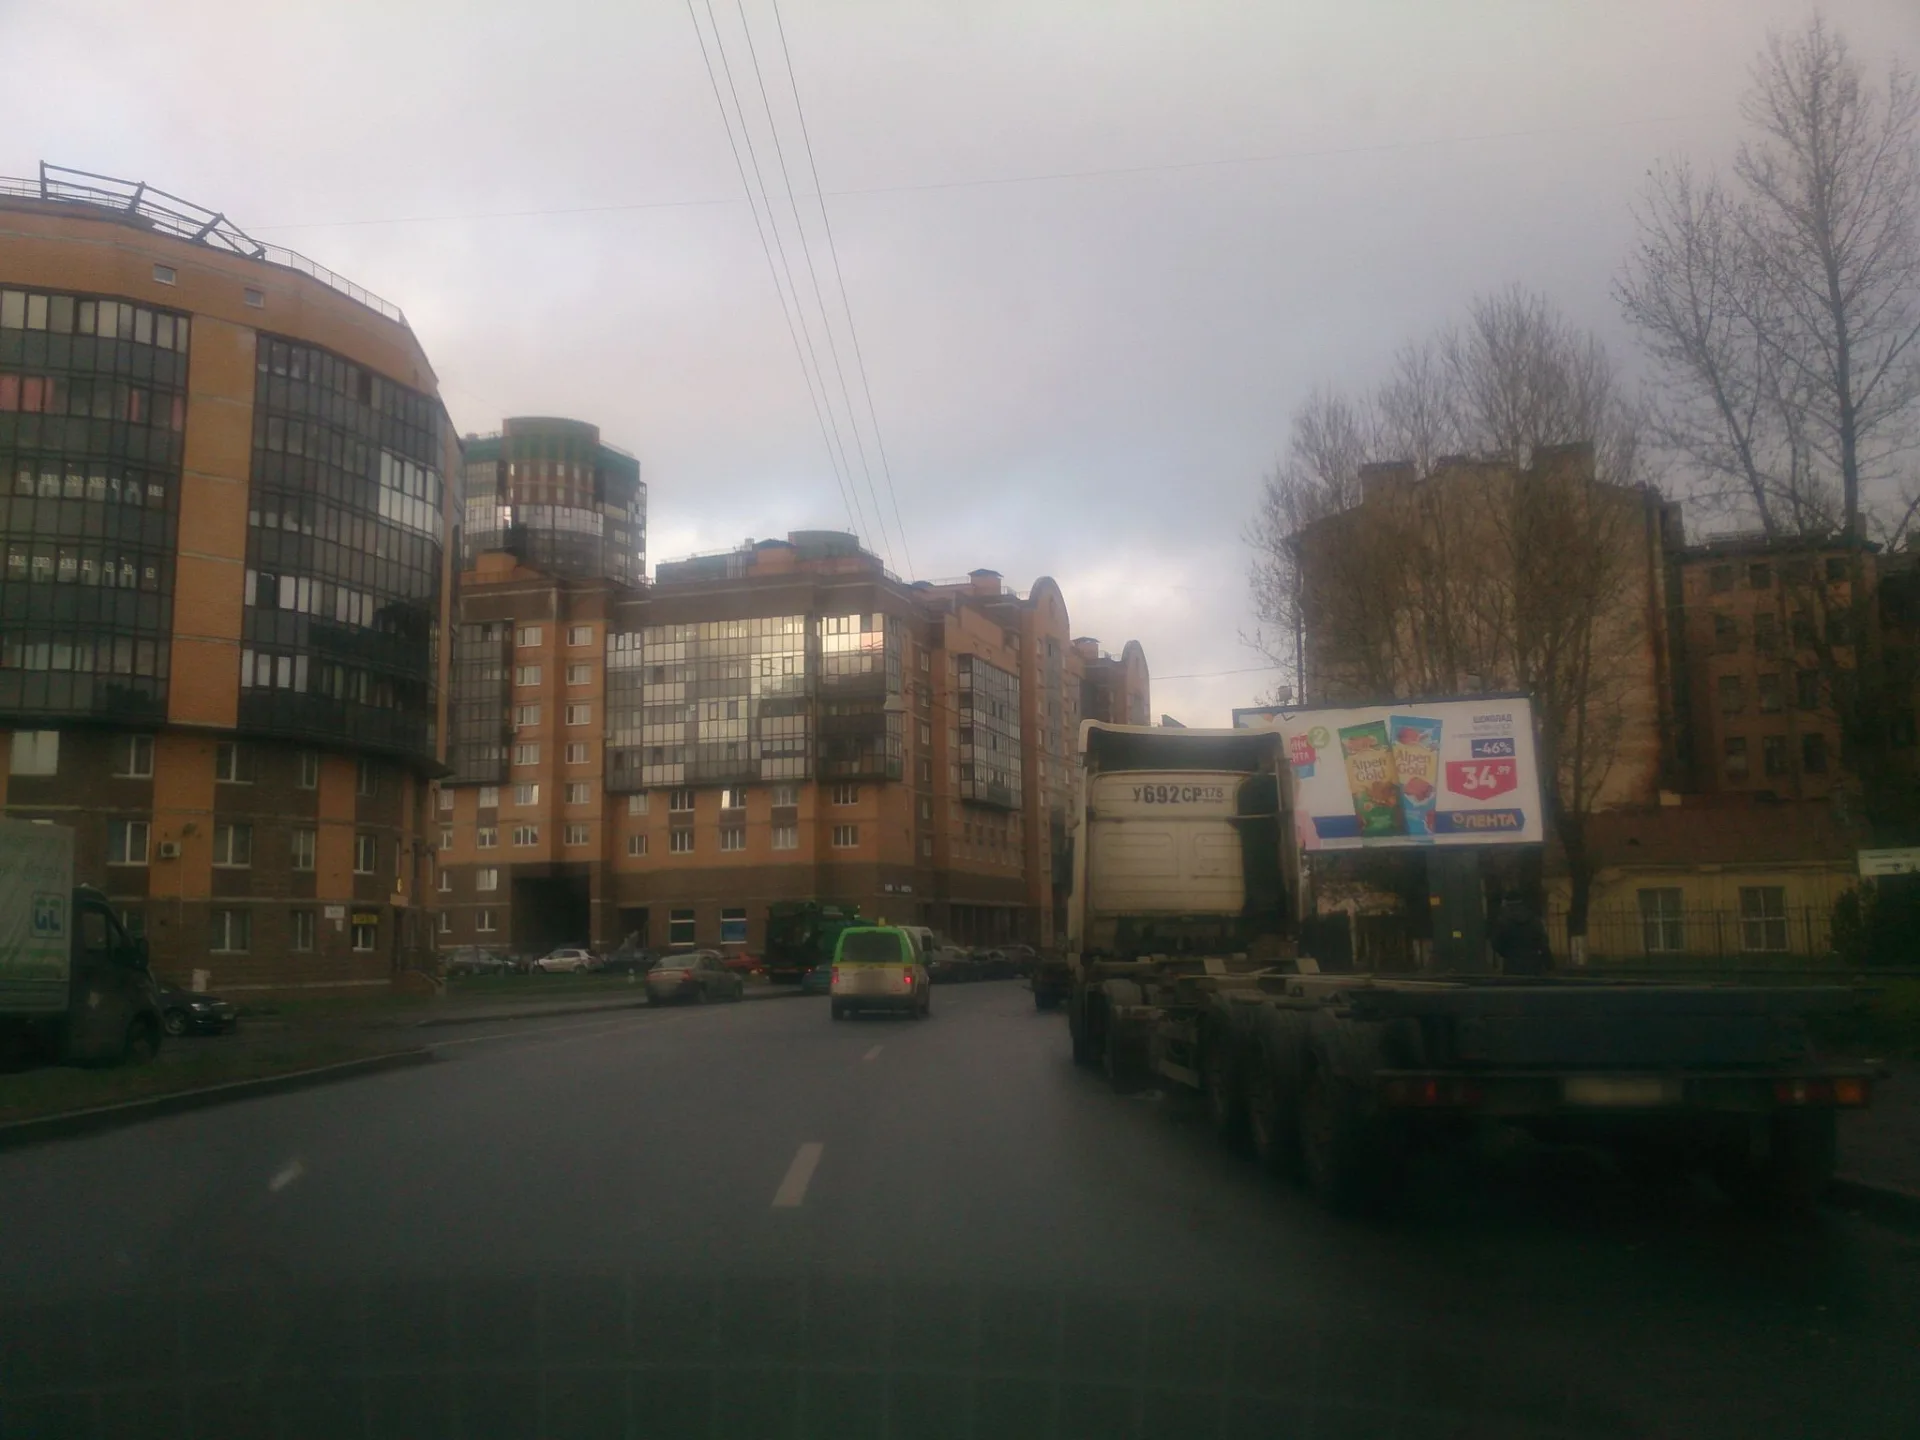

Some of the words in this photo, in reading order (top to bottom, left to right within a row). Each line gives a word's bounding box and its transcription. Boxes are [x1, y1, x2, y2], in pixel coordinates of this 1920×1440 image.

[1314, 729, 1325, 746] 2
[1396, 750, 1431, 764] Alpen
[1352, 758, 1386, 772] Alpen
[1398, 763, 1427, 776] Gold
[1355, 767, 1385, 782] Gold
[1460, 766, 1497, 790] 34
[1465, 813, 1518, 828] ЛЕНТА
